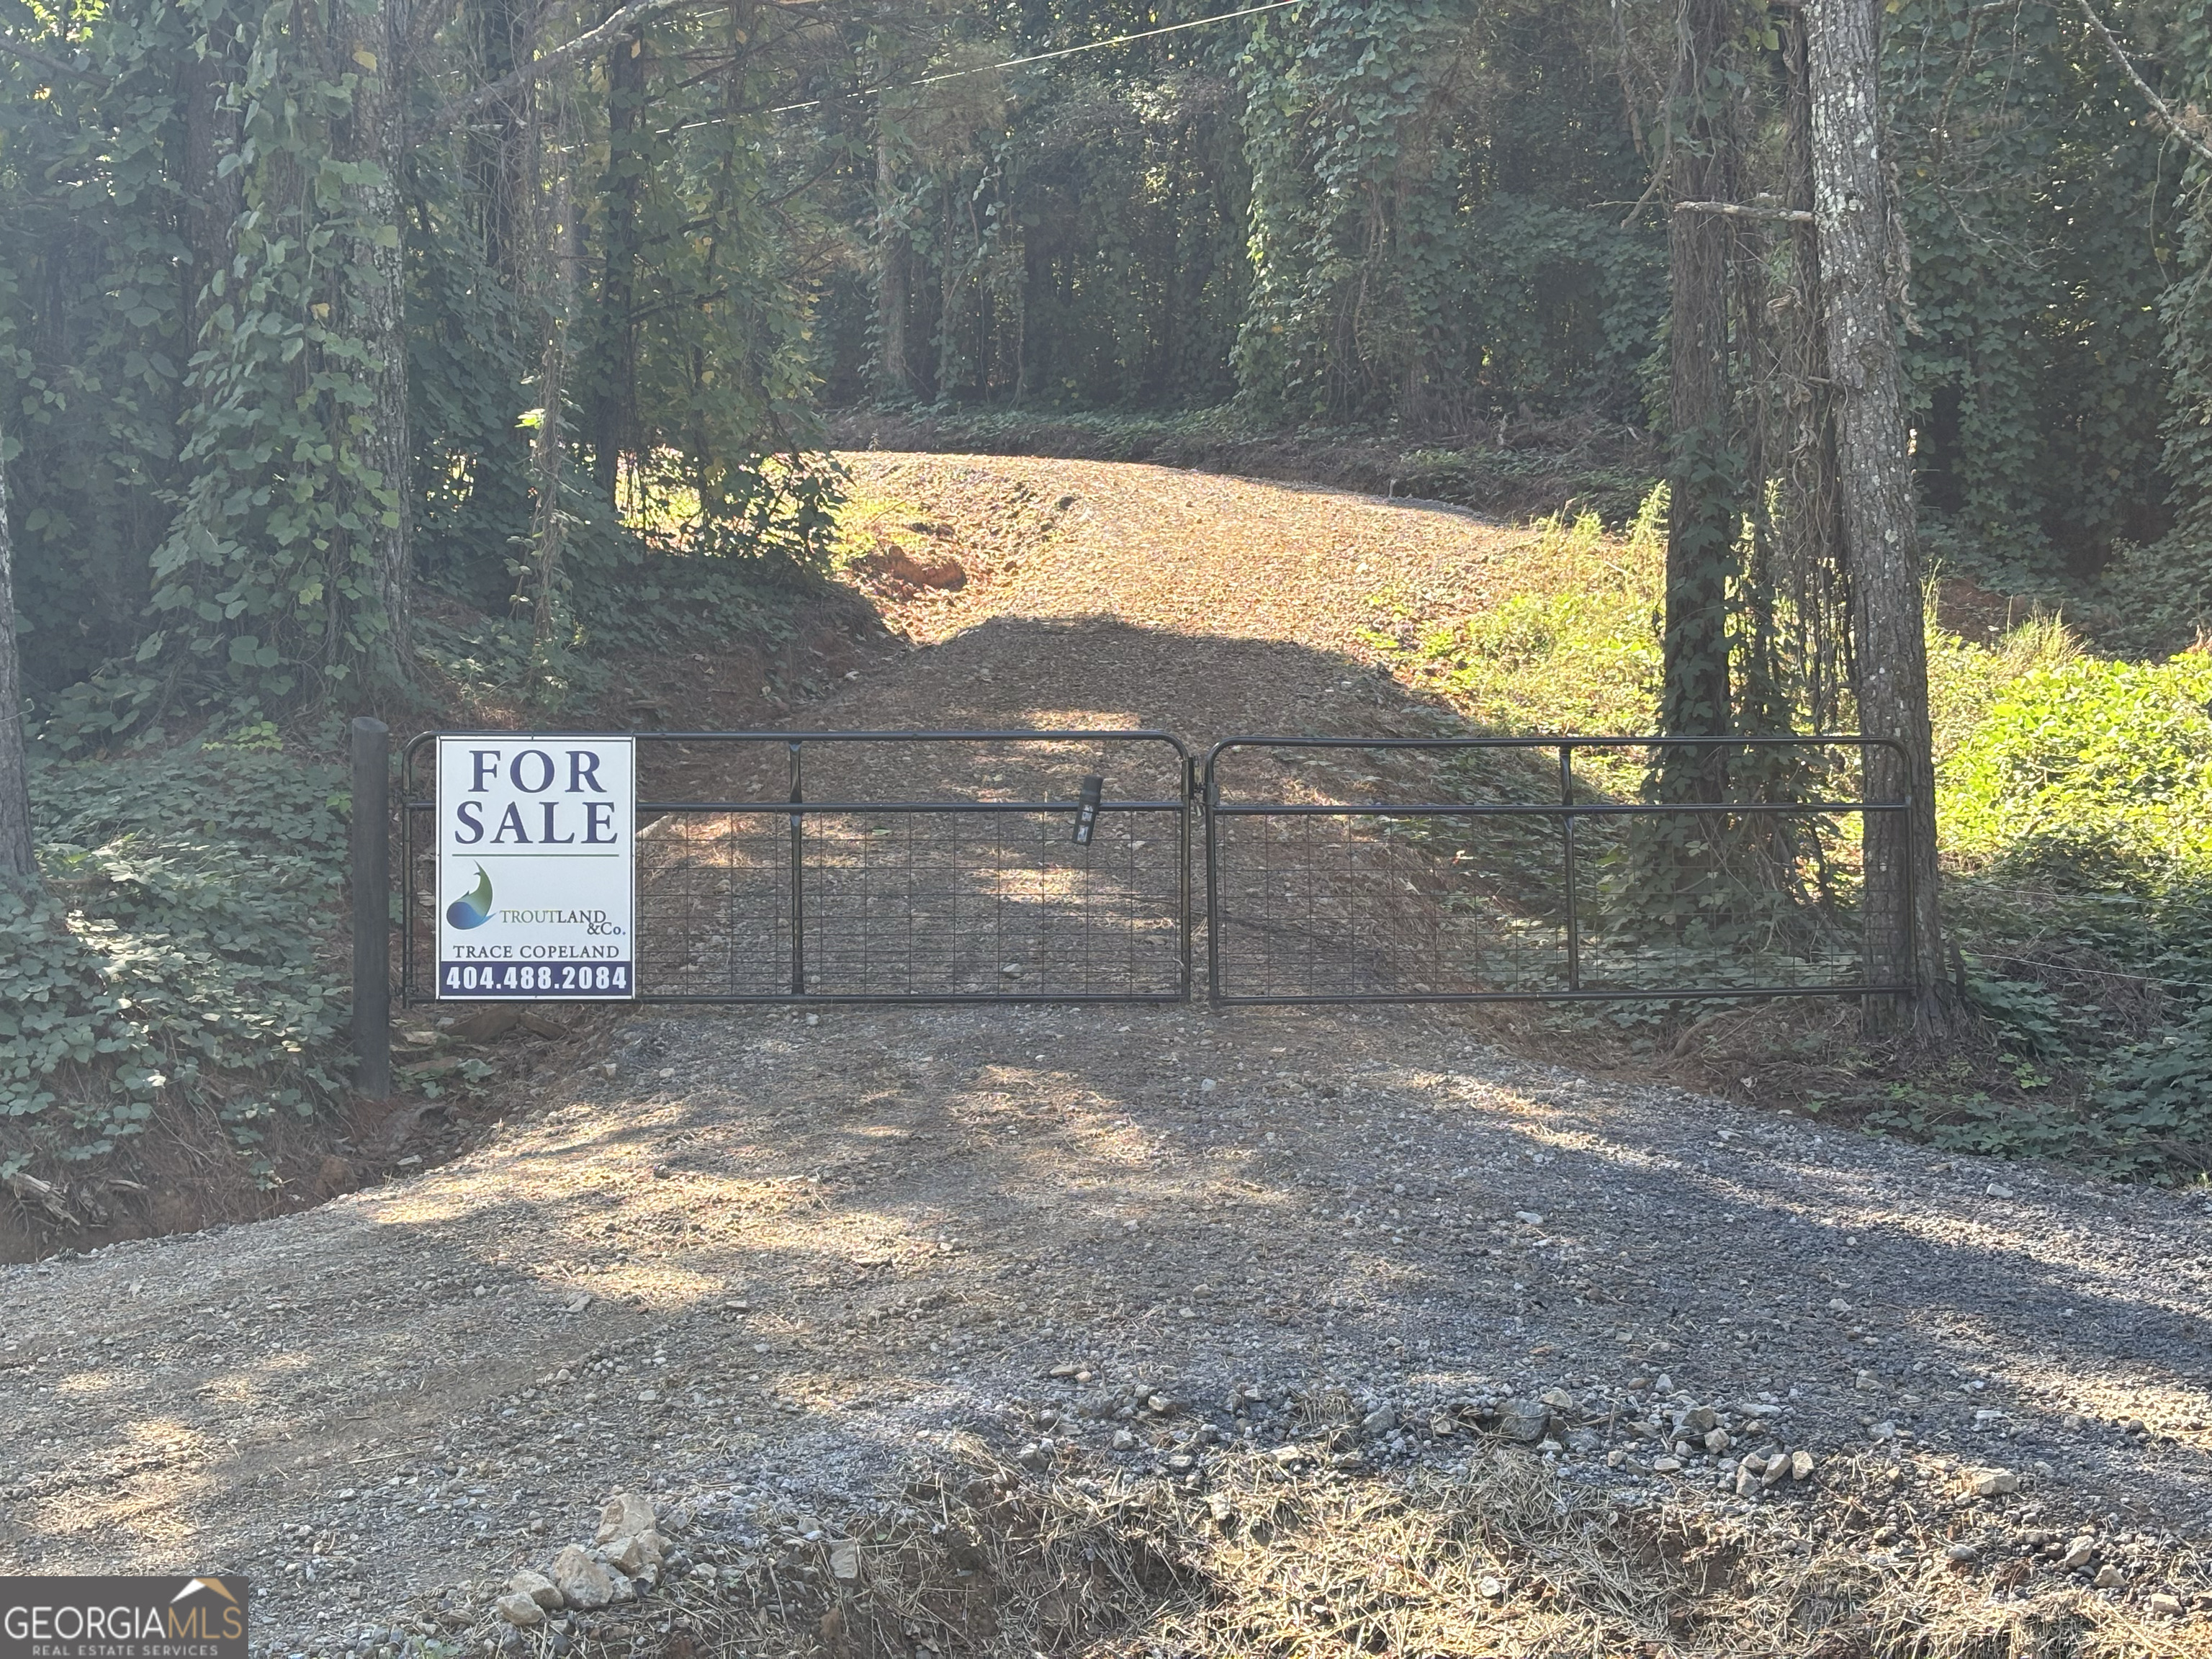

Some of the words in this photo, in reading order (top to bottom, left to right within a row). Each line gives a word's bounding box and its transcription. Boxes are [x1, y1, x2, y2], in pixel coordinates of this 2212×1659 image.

[467, 749, 607, 793] FOR
[454, 800, 619, 845] SALE
[499, 909, 607, 924] TROUTLAND
[586, 922, 626, 936] &Co.
[452, 945, 513, 958] TRACE
[519, 945, 620, 958] COPELAND
[446, 966, 627, 989] 404.488.2084
